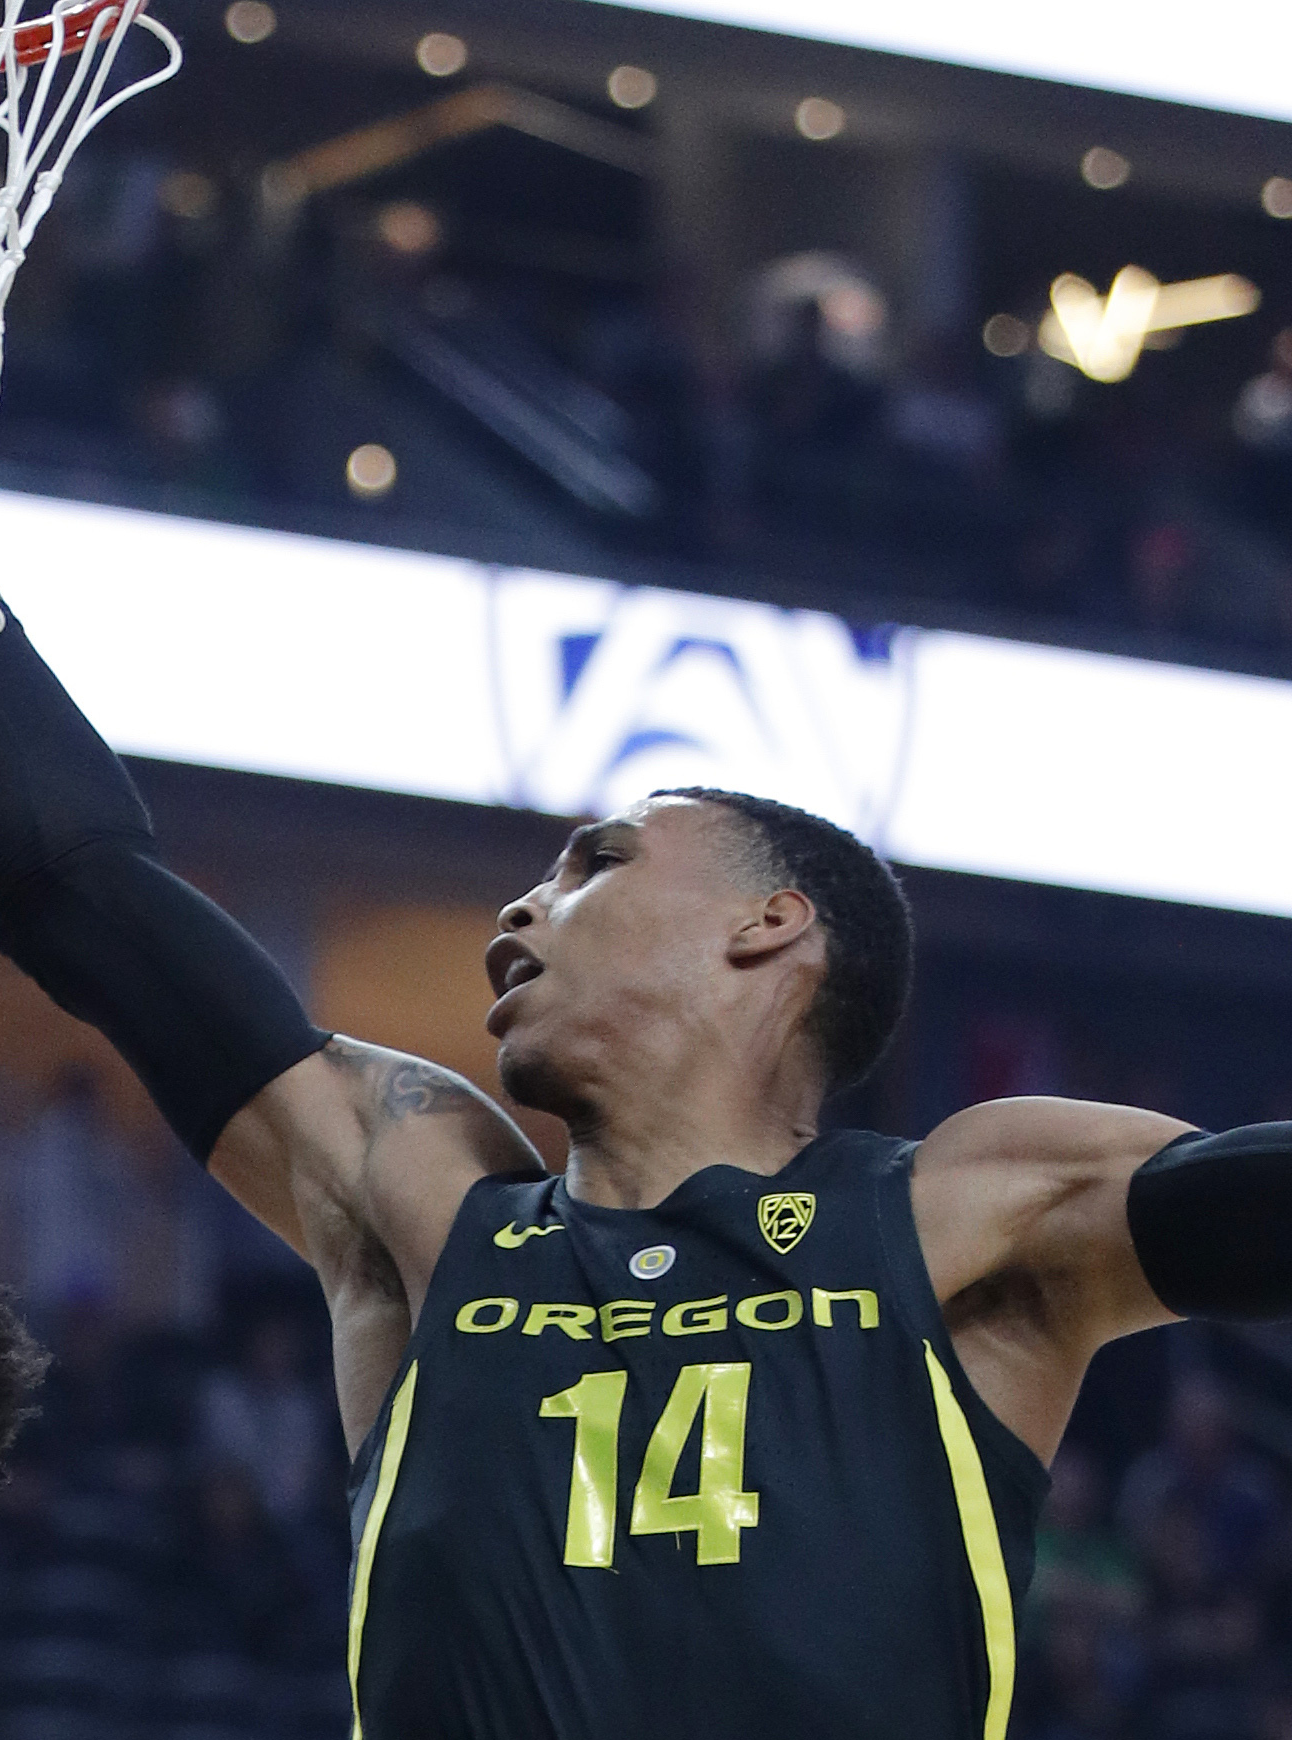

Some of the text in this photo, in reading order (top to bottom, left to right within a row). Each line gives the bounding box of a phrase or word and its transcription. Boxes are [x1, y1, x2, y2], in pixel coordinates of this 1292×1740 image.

[762, 1195, 813, 1231] PAC
[771, 1217, 798, 1240] 12
[454, 1287, 881, 1342] OREGON
[538, 1361, 761, 1568] 14
